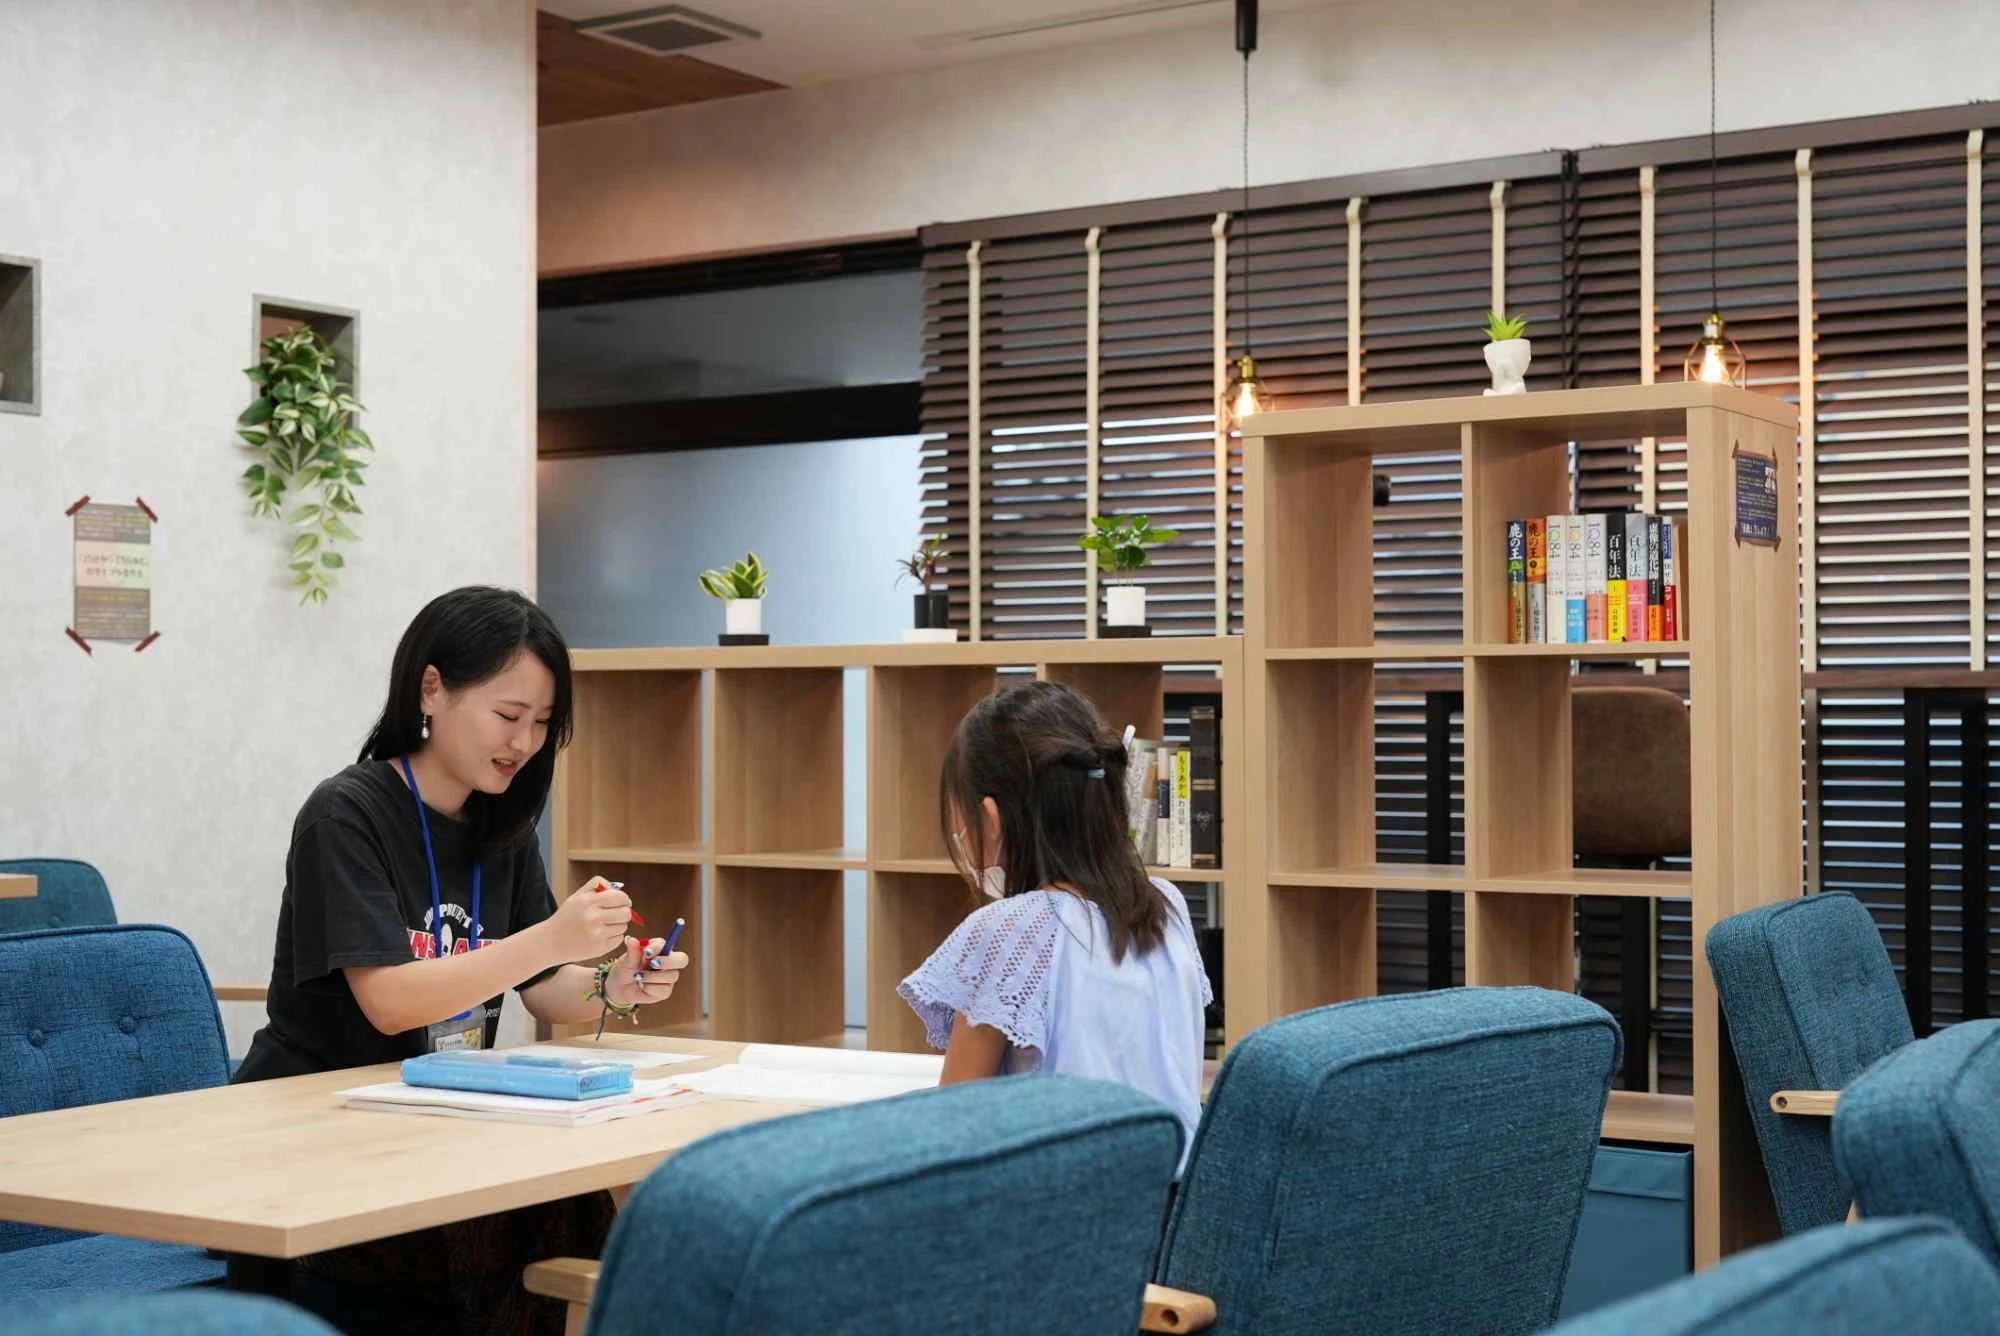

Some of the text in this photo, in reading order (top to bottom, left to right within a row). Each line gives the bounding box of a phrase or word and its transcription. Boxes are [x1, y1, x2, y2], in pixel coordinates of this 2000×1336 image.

[1509, 523, 1522, 561] 鹿の王
[1528, 523, 1541, 559] 鹿の王
[1608, 534, 1621, 578] 百年法
[1629, 534, 1641, 577] 百年法
